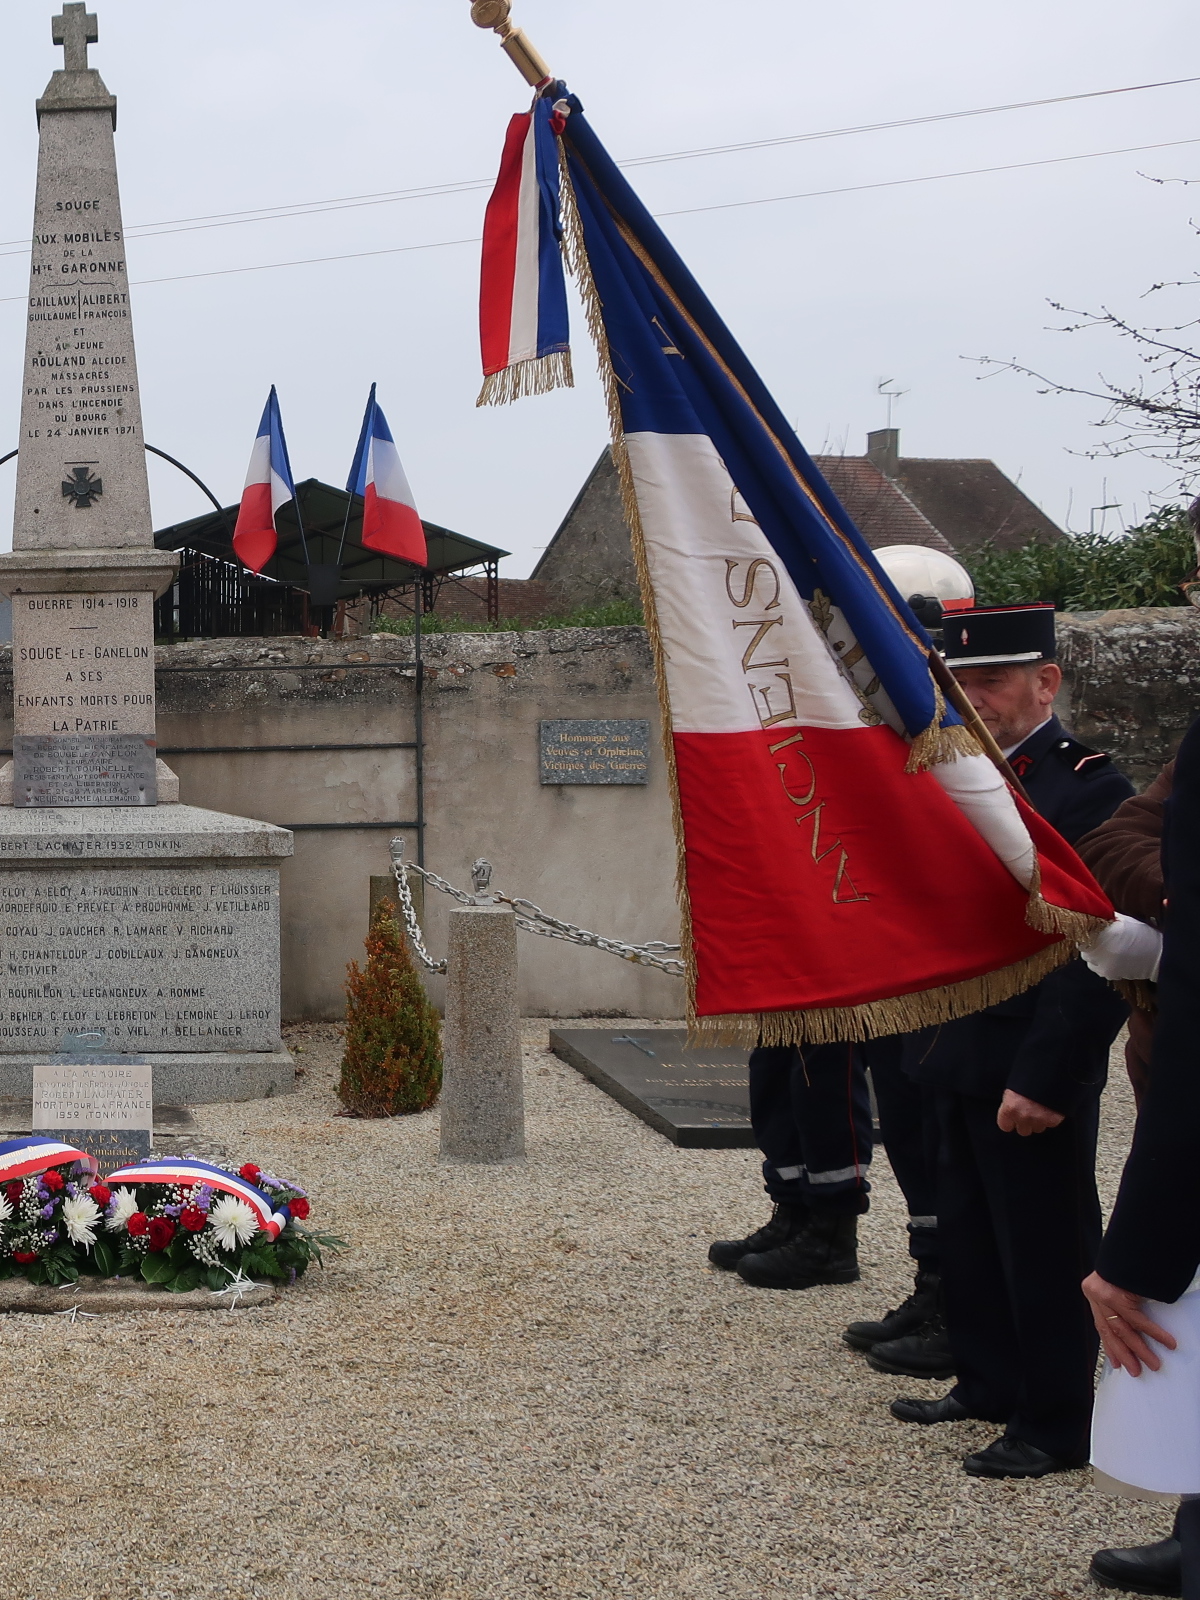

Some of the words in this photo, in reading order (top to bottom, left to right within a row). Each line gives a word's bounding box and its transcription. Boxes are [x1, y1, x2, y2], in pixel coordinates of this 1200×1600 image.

[64, 231, 122, 244] MOBILES
[63, 249, 76, 258] DE
[81, 248, 93, 257] LA
[61, 261, 125, 274] GARONNE
[29, 295, 77, 307] CAILLAUX
[82, 293, 127, 306] ALIBERT
[28, 311, 77, 322] GUILLAUME
[83, 309, 127, 320] FRANÇOIS
[73, 327, 86, 336] ET
[73, 341, 105, 350] JEUNE
[32, 355, 86, 367] ROULAND
[91, 356, 127, 365] ALCIDE
[27, 387, 48, 396] PAR
[55, 386, 73, 395] LES
[81, 384, 135, 394] PRUSSIENS
[38, 400, 64, 410] DANS
[72, 398, 124, 409] L'INCENDIE
[54, 414, 67, 423] DU
[75, 413, 107, 422] BOURG
[28, 429, 41, 438] LE
[46, 429, 62, 438] 24
[67, 427, 110, 437] JANVIER
[115, 425, 136, 435] 1871
[28, 599, 73, 610] GUERRE
[65, 671, 73, 682] A
[80, 671, 103, 682] SES
[18, 694, 74, 707] ENFANTS
[80, 694, 118, 706] MORTS
[123, 694, 153, 705] POUR
[53, 720, 69, 732] LA
[75, 717, 119, 731] PATRIE
[725, 557, 870, 905] ANCIENS
[559, 733, 608, 745] Hommage
[612, 734, 631, 742] aux
[90, 750, 137, 758] GANELON
[545, 746, 580, 756] Veuves
[584, 747, 593, 756] et
[597, 746, 644, 758] Orphelins
[75, 765, 134, 773] TOURNELLE
[543, 760, 585, 770] Victimes
[589, 760, 606, 770] des
[609, 761, 648, 770] Guerres
[36, 840, 101, 851] LACHATER
[106, 841, 133, 850] 1952
[140, 840, 181, 849] TONKIN
[2, 887, 27, 897] ELOY
[47, 886, 73, 897] ELOY
[158, 885, 202, 896] LECLERC
[221, 885, 271, 896] LHUISSIER
[77, 902, 116, 913] PREVET
[135, 901, 195, 912] PRODHOMME
[5, 926, 39, 937] COYAU
[59, 925, 106, 937] GAUCHER
[126, 925, 169, 936] LAMARE
[190, 925, 233, 935] RICHARD
[21, 949, 88, 960] CHANTELOUP
[184, 948, 240, 959] GANGNEUX
[9, 964, 58, 976] METIVIER
[8, 987, 63, 999] BOURILLON
[170, 987, 206, 998] ROMME
[10, 1011, 43, 1023] BEHIER
[62, 1010, 87, 1021] ELOY
[107, 1010, 157, 1021] LEBRETON
[176, 1009, 219, 1020] LEMOINE
[239, 1009, 271, 1020] LEROY
[175, 1025, 243, 1036] BELLANGER
[63, 1069, 78, 1078] LA
[82, 1069, 132, 1078] MEMOIRE
[41, 1090, 81, 1099] ROBERT
[83, 1089, 144, 1099] LACHATER
[34, 1101, 64, 1110] MORT
[66, 1101, 92, 1110] POUR
[93, 1101, 106, 1109] LA
[109, 1100, 151, 1109] FRANCE
[55, 1111, 80, 1119] 1952
[62, 1134, 81, 1144] Les
[26, 1145, 38, 1153] De
[84, 1146, 139, 1156] Camarades
